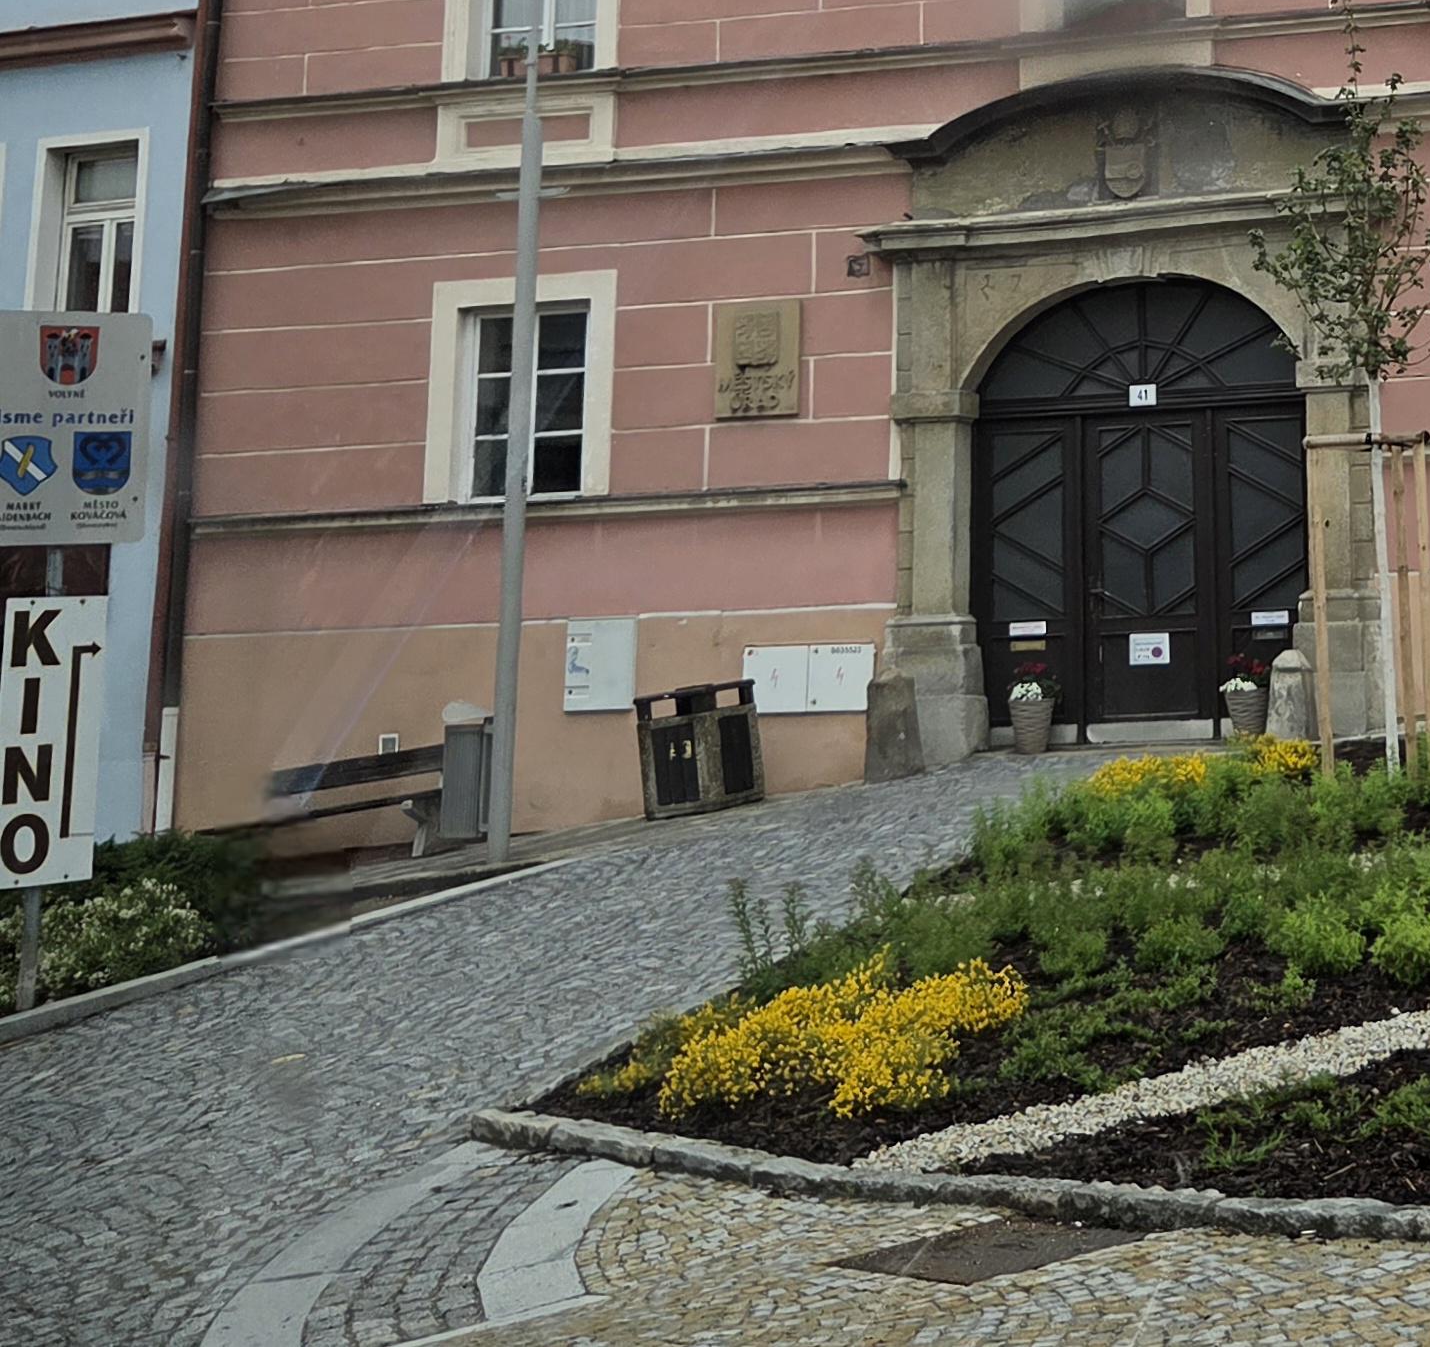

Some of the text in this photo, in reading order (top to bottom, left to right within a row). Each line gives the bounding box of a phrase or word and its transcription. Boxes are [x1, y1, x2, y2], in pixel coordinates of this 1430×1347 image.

[1137, 389, 1148, 401] 41
[0, 407, 134, 427] sme partneři
[0, 609, 62, 875] KINO
